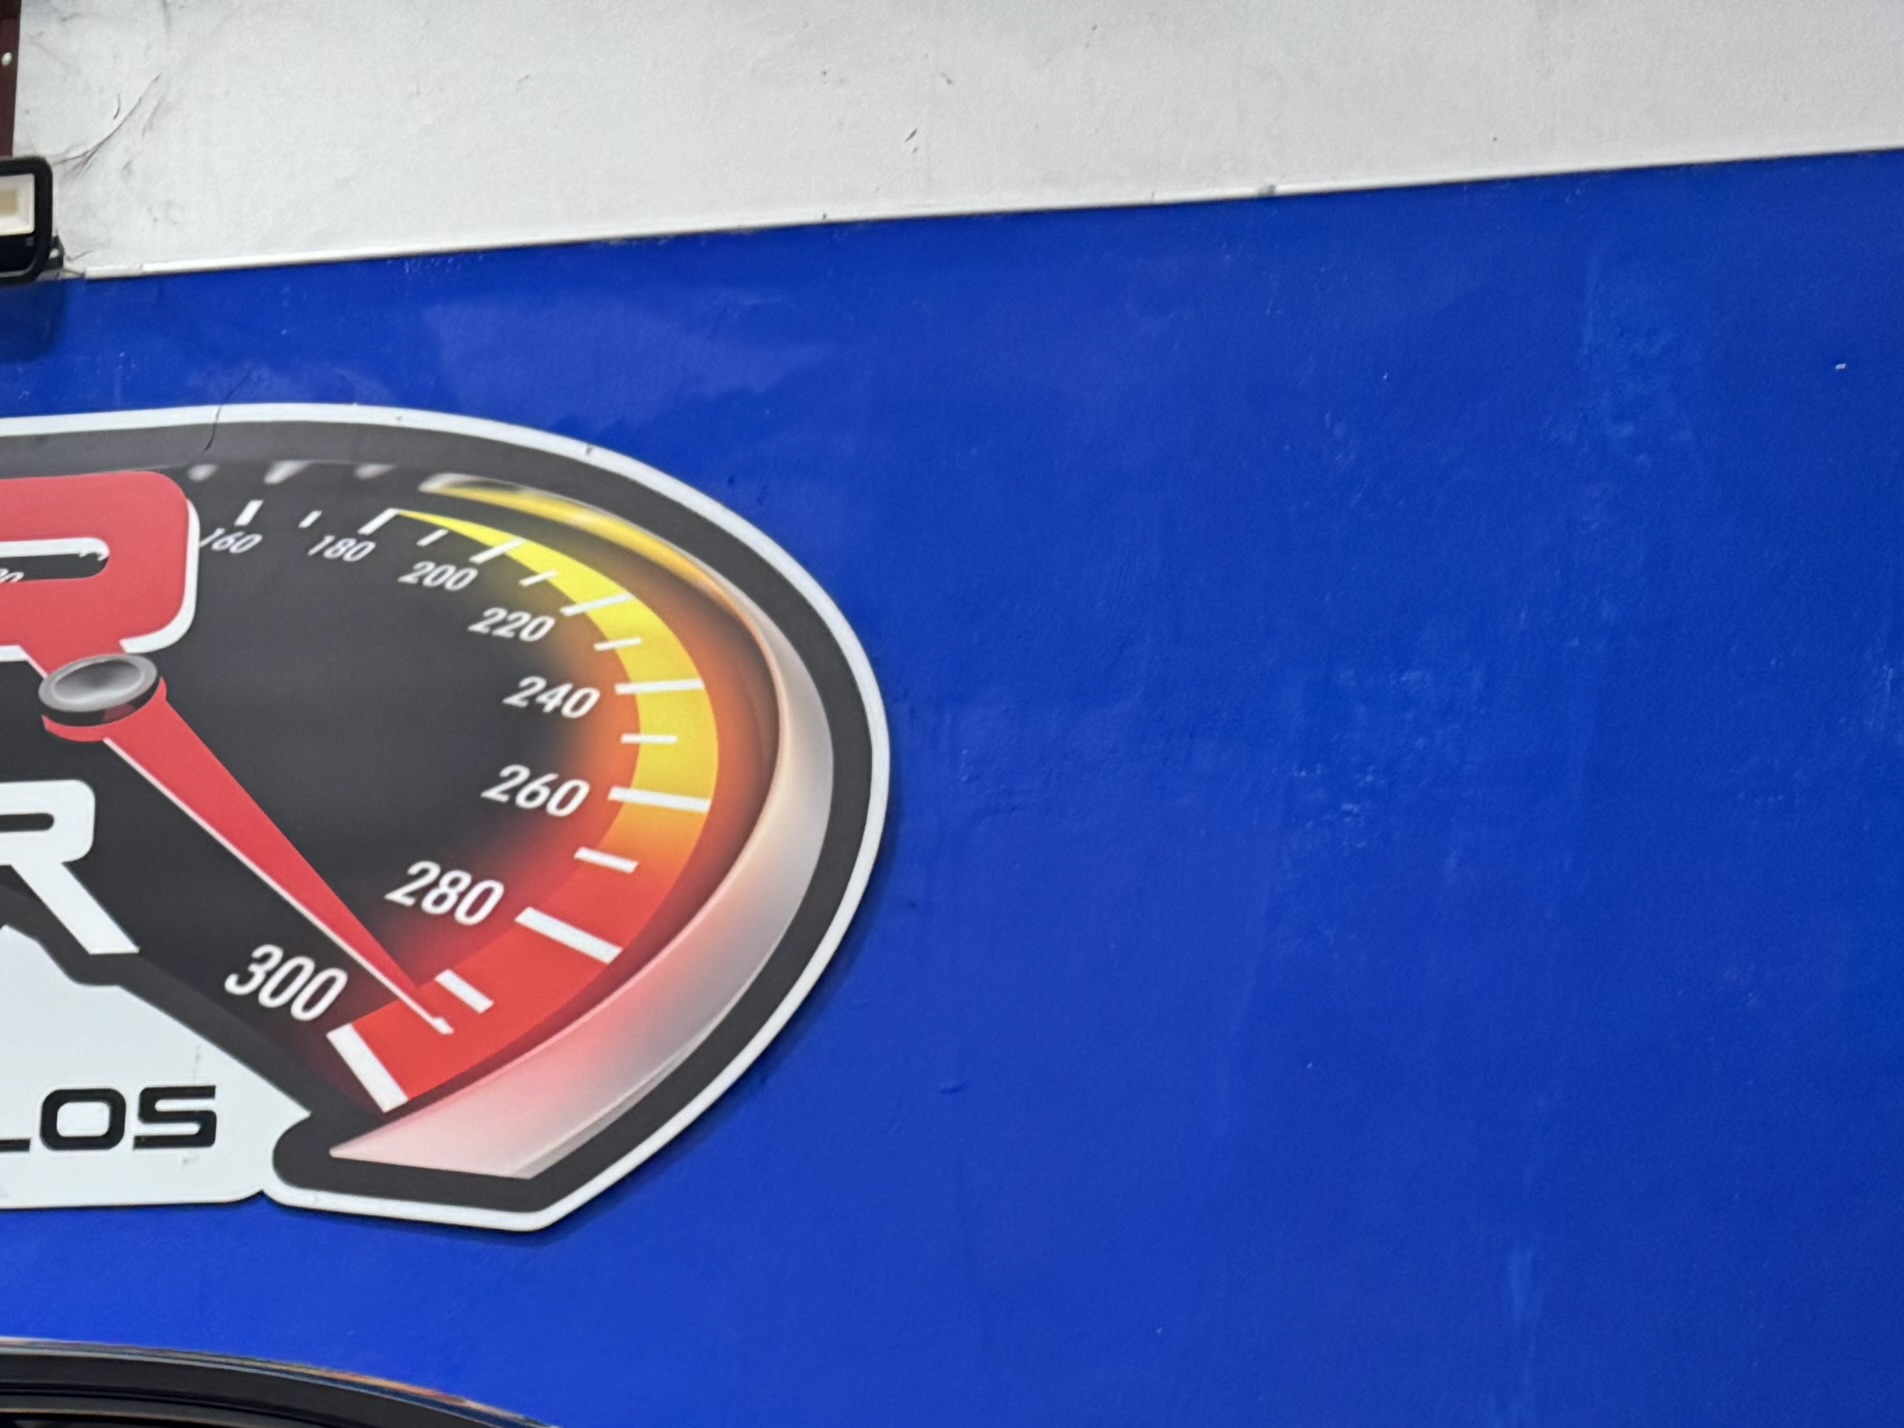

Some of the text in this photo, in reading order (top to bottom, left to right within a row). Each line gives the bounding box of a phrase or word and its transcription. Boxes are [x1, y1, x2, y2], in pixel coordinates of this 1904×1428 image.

[199, 528, 263, 554] 160
[308, 535, 376, 562] 180
[398, 561, 479, 591] 200
[469, 605, 555, 643] 220
[503, 676, 600, 720] 240
[482, 765, 590, 817] 260
[386, 860, 504, 926] 280
[224, 943, 349, 1021] 300
